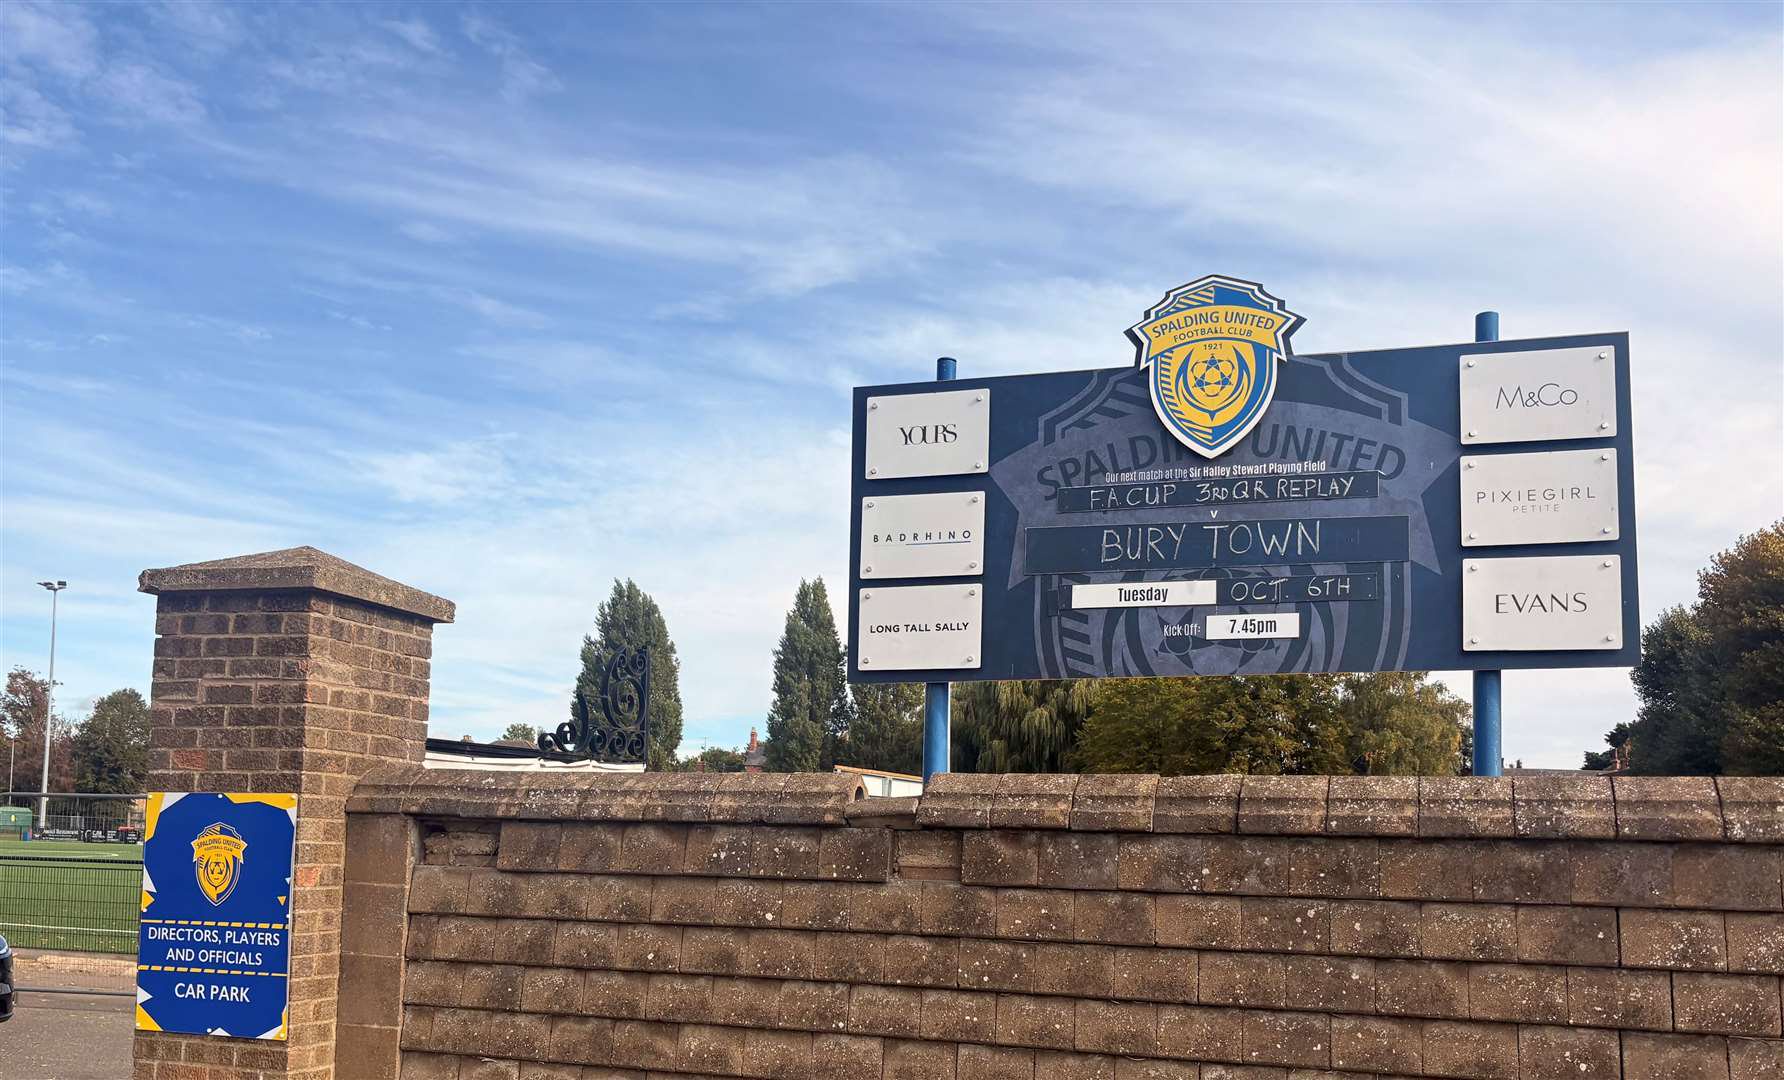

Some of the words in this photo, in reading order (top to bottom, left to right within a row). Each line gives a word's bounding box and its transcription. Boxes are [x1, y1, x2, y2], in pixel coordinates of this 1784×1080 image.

[1152, 310, 1220, 339] SPALDING
[1224, 311, 1276, 331] UNITED
[1173, 328, 1225, 343] FOOTBALL
[1227, 327, 1253, 337] CLUB
[1203, 343, 1224, 351] 1921
[1496, 383, 1578, 409] M&Co
[898, 423, 958, 446] YOURS
[1105, 472, 1119, 483] Our
[1120, 471, 1137, 482] next
[1138, 469, 1163, 481] match
[1164, 468, 1173, 480] at
[1174, 467, 1188, 479] the
[1189, 467, 1201, 478] Sir
[1203, 465, 1231, 477] Halley
[1232, 463, 1267, 476] Stewart
[1268, 461, 1302, 475] Playing
[1303, 460, 1326, 473] Field
[1276, 476, 1354, 498] REPLAY
[1476, 486, 1596, 504] PIXIEGIRL
[1512, 503, 1560, 513] PETITE
[873, 530, 971, 543] BADRHINO
[1101, 524, 1186, 563] BURY
[1203, 520, 1320, 559] TOWN
[1118, 586, 1168, 603] Tuesday
[1307, 576, 1350, 597] 6TH
[1495, 592, 1588, 614] EVANS
[869, 624, 900, 634] LONG
[904, 623, 931, 633] TALL
[935, 621, 969, 632] SALLY
[1163, 625, 1183, 637] Kick
[1184, 623, 1201, 636] Off:
[1229, 618, 1277, 635] 7.45pm
[148, 927, 222, 945] DIRECTORS,
[225, 931, 280, 946] PLAYERS
[166, 948, 195, 962] AND
[198, 950, 262, 966] OFFICIALS
[174, 983, 206, 999] CAR
[210, 985, 250, 1002] PARK
